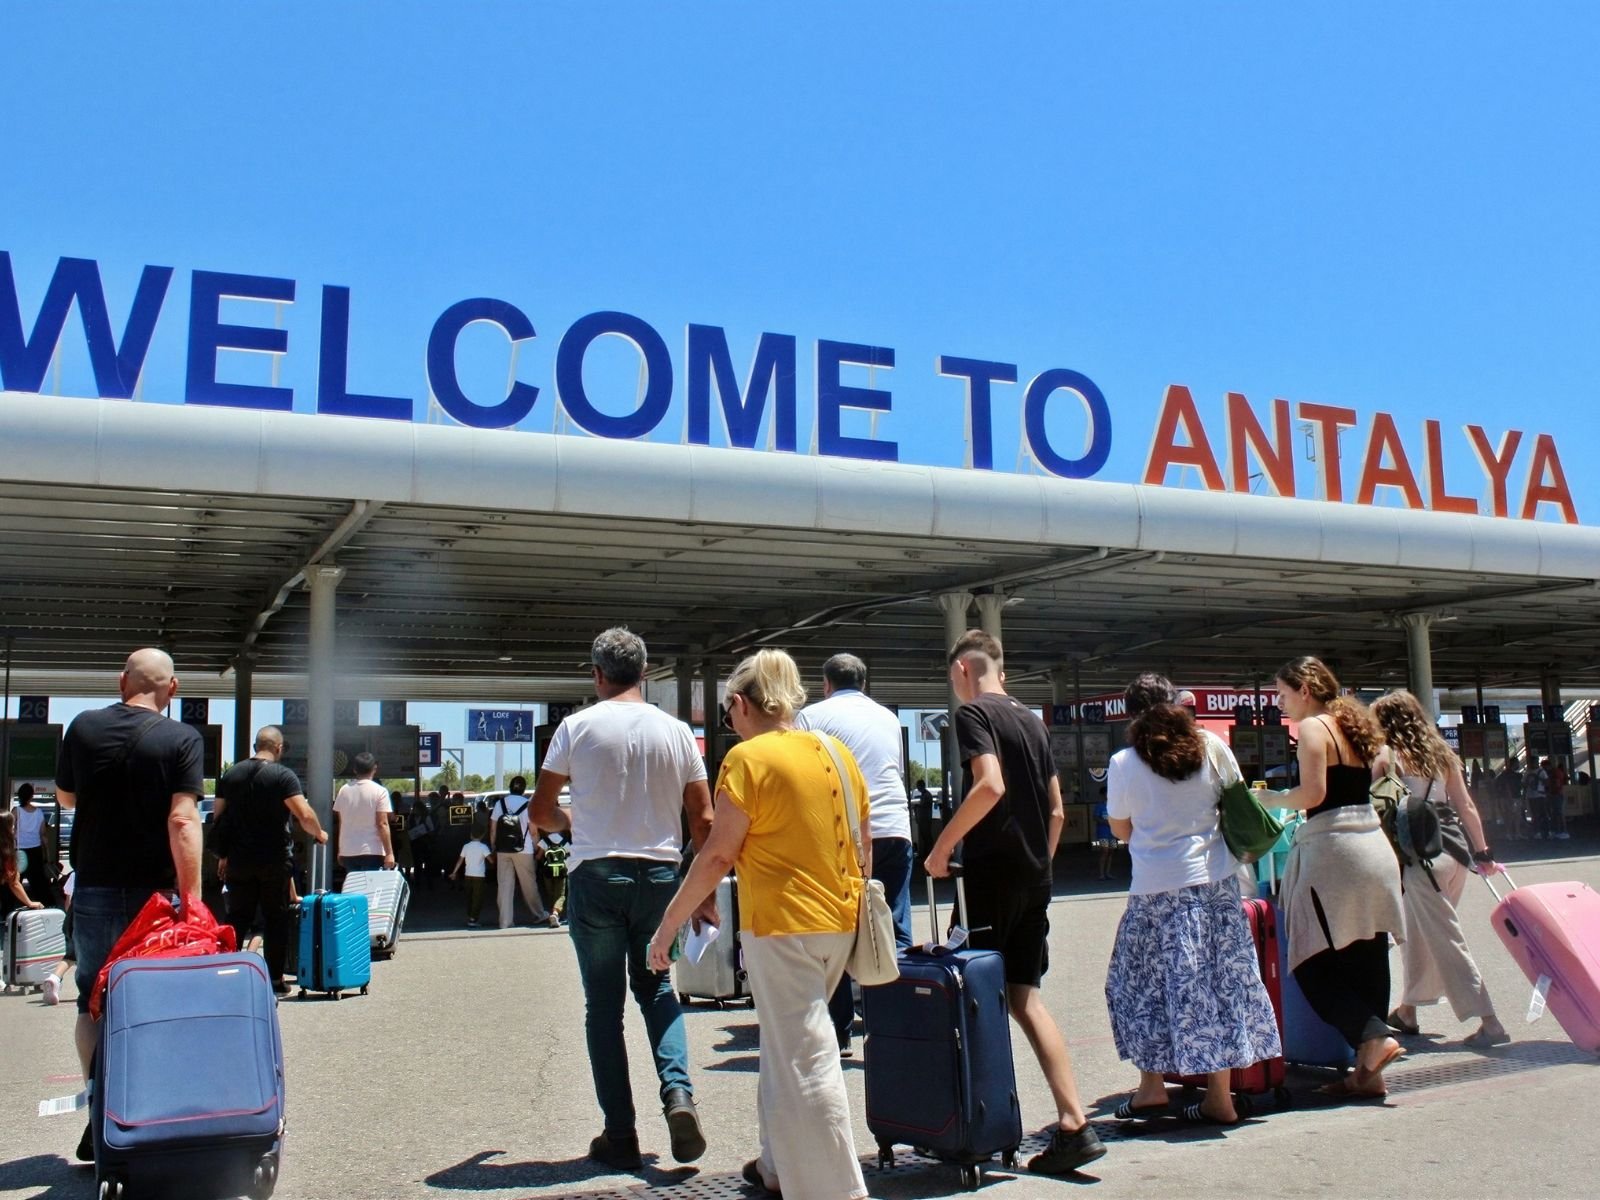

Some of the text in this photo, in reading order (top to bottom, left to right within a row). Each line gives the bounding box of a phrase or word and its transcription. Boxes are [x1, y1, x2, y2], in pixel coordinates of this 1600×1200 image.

[0, 250, 1579, 524] WELCOME TO ANTALYA
[20, 700, 47, 719] 26
[183, 702, 206, 720] 28
[285, 703, 308, 721] 29
[1105, 698, 1127, 716] KIN
